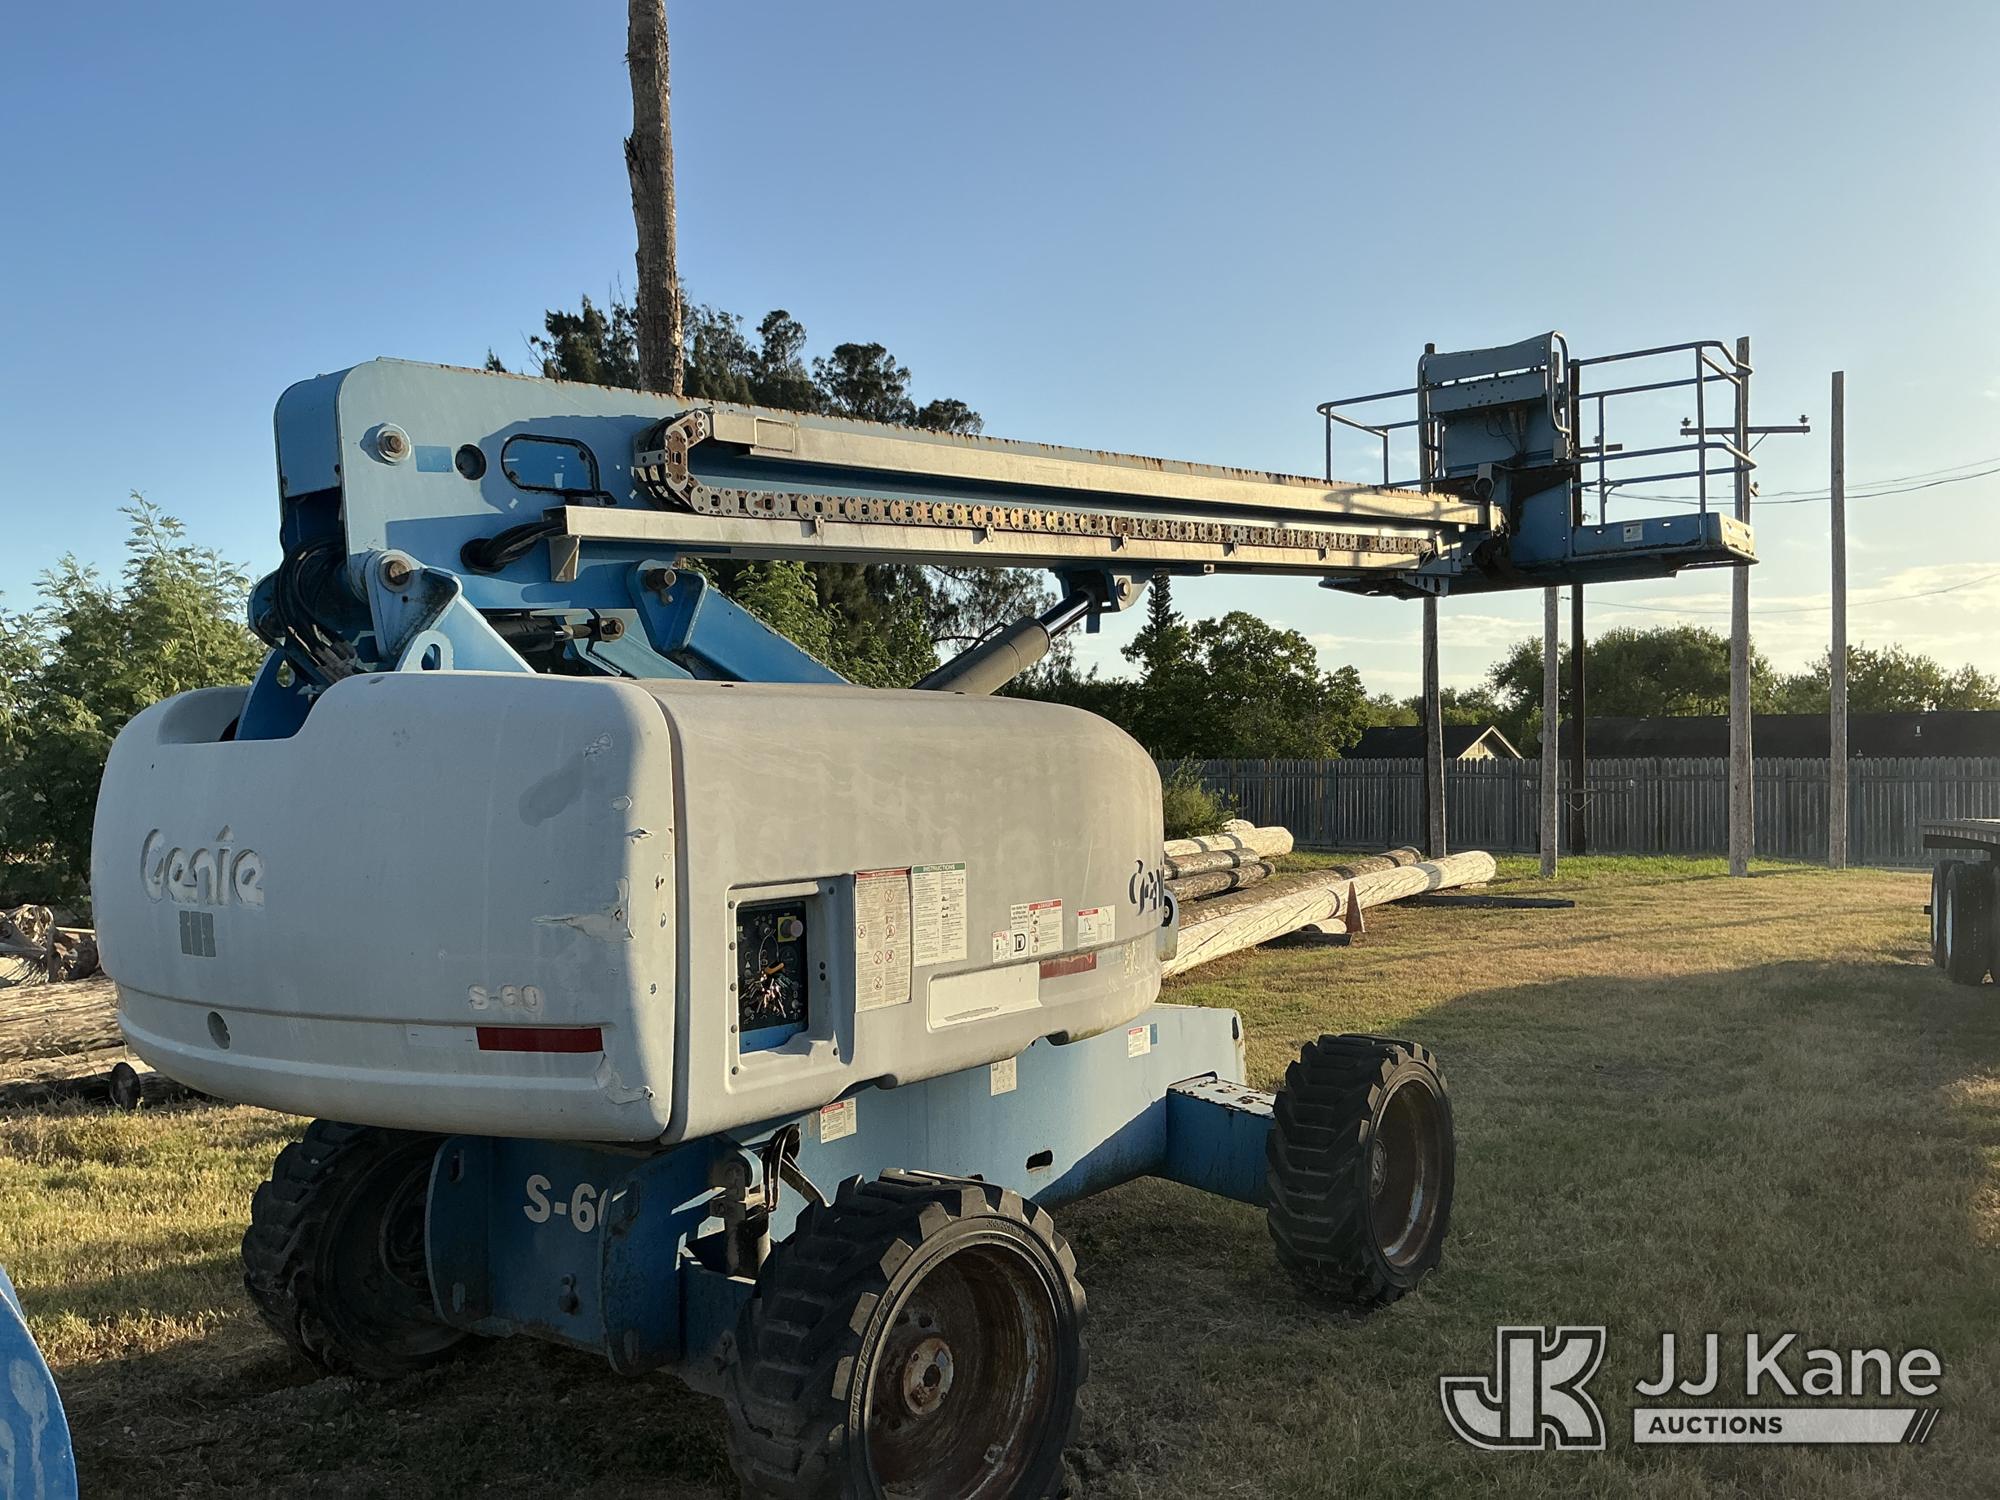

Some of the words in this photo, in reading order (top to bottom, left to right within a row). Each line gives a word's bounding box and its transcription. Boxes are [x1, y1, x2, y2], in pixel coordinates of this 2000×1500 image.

[140, 824, 264, 907] Genie
[922, 863, 956, 873] INSTRUCTIONS
[523, 1174, 608, 1233] S-6
